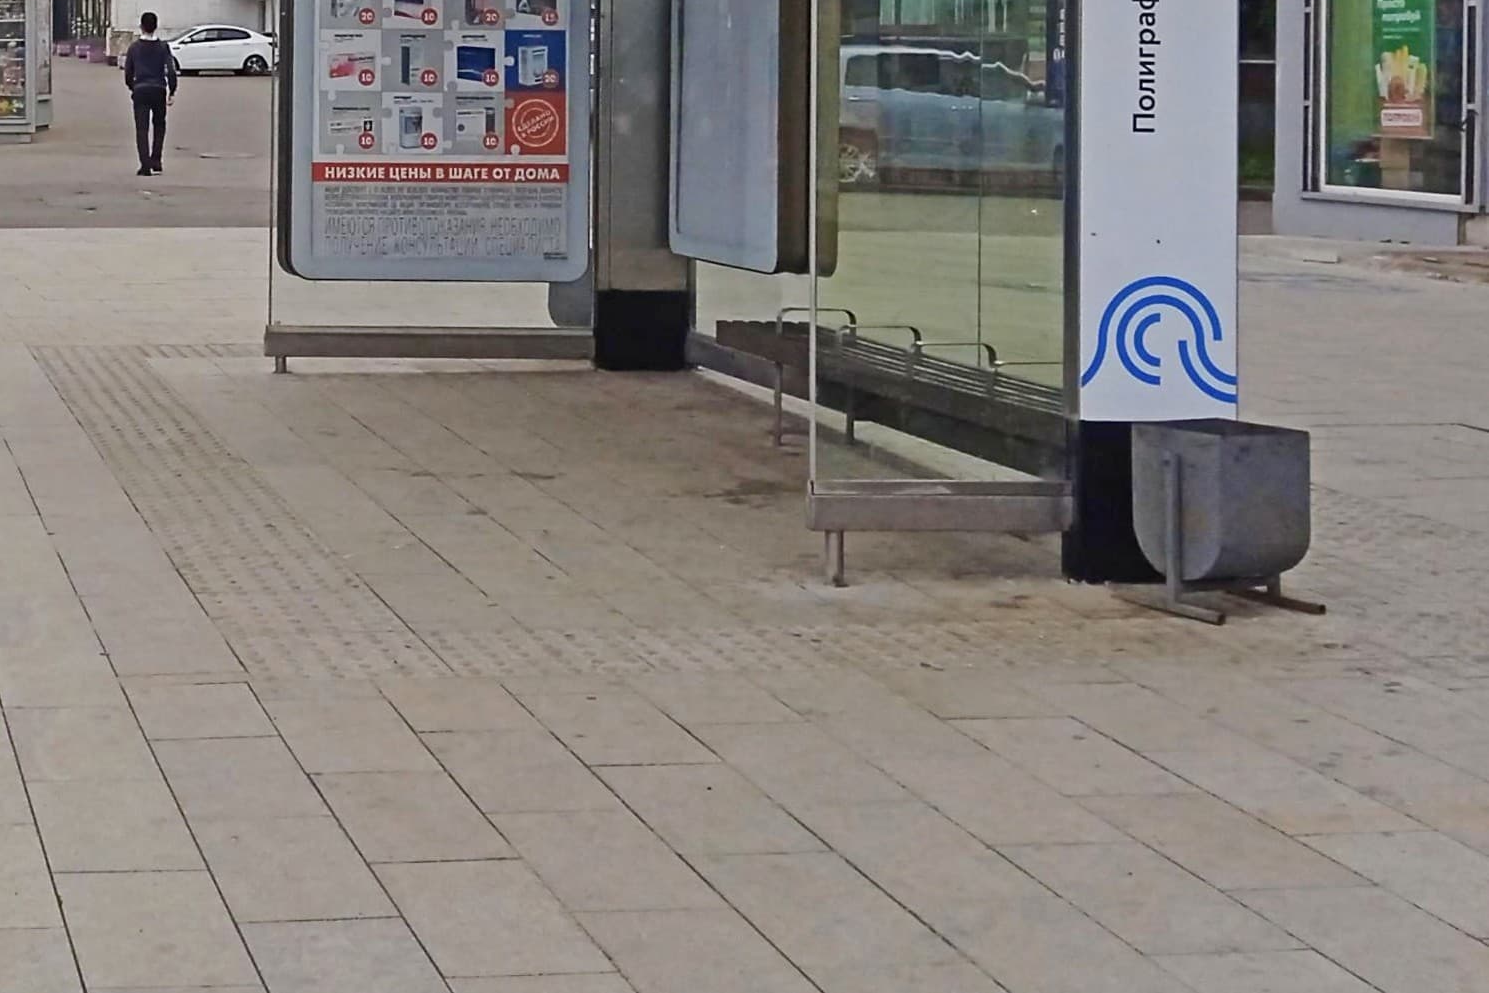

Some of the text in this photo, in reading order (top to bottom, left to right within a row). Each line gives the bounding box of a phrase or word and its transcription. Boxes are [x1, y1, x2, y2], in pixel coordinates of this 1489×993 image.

[325, 166, 560, 181] НИЗКИЕ ЦЕНЫ В ШАГЕ ОТ ДОМА
